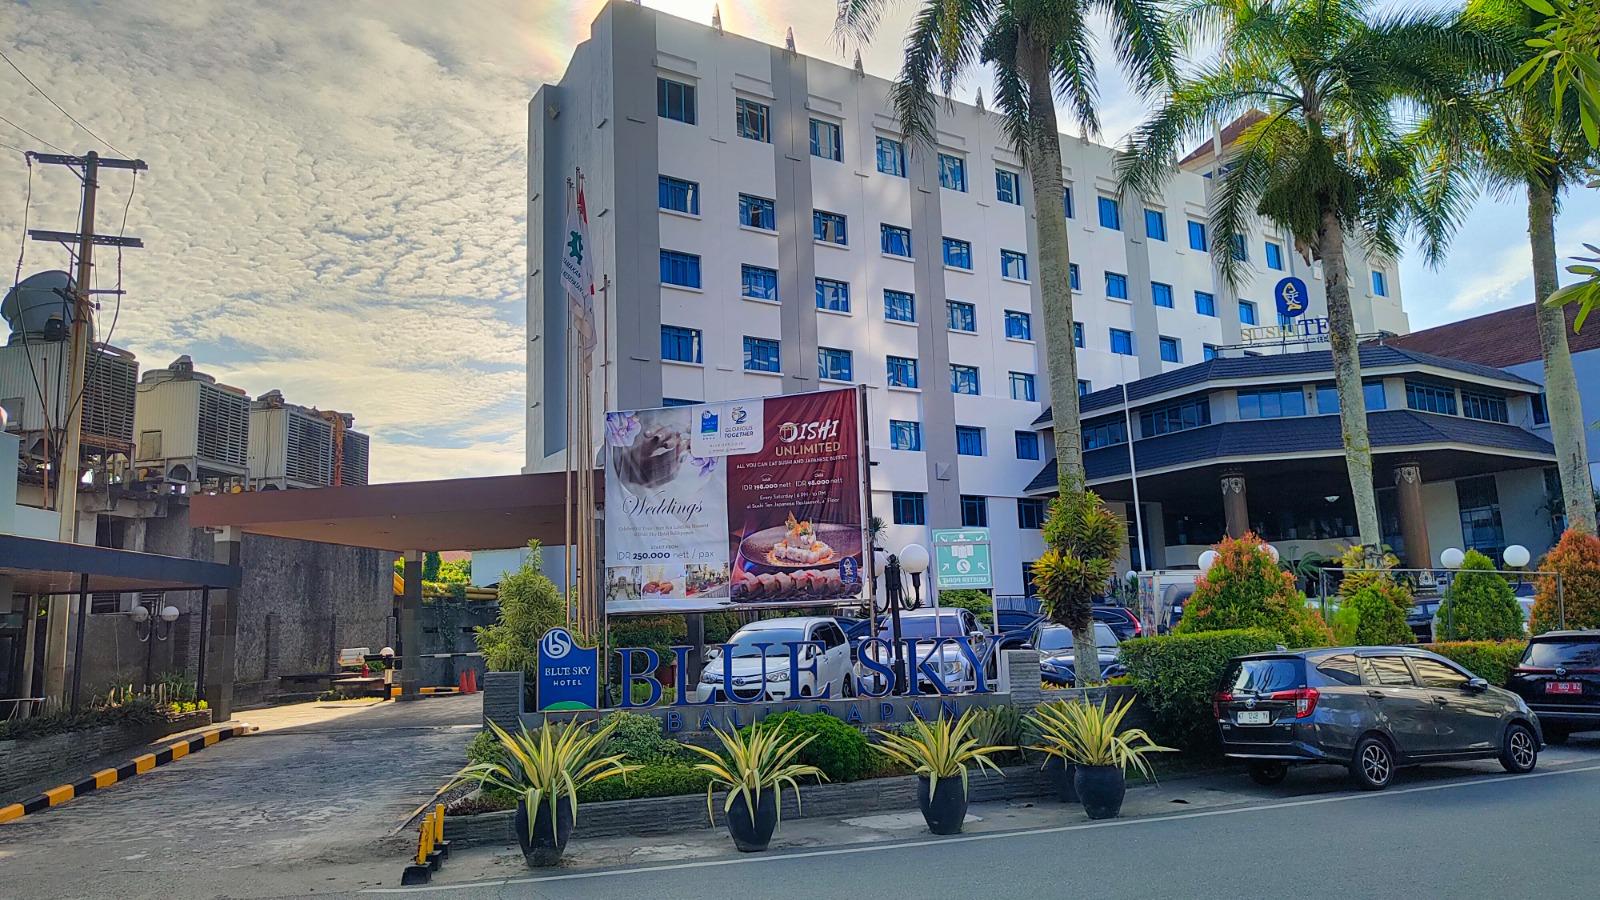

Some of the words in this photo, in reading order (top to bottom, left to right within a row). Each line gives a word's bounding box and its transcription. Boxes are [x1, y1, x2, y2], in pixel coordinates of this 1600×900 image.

[1298, 317, 1330, 336] TE
[724, 431, 754, 439] TOGETHER
[778, 419, 840, 443] OISHI
[775, 442, 841, 457] UNLIMITED
[805, 456, 828, 464] JAPANESE
[829, 454, 848, 462] BUFFET
[622, 490, 703, 521] Weddings
[616, 551, 631, 560] IDR
[632, 552, 671, 561] 250.000
[698, 550, 714, 559] pax
[545, 667, 571, 676] BLUE
[572, 666, 591, 675] SKY
[614, 640, 831, 708] BLUE
[857, 635, 1004, 698] SKY
